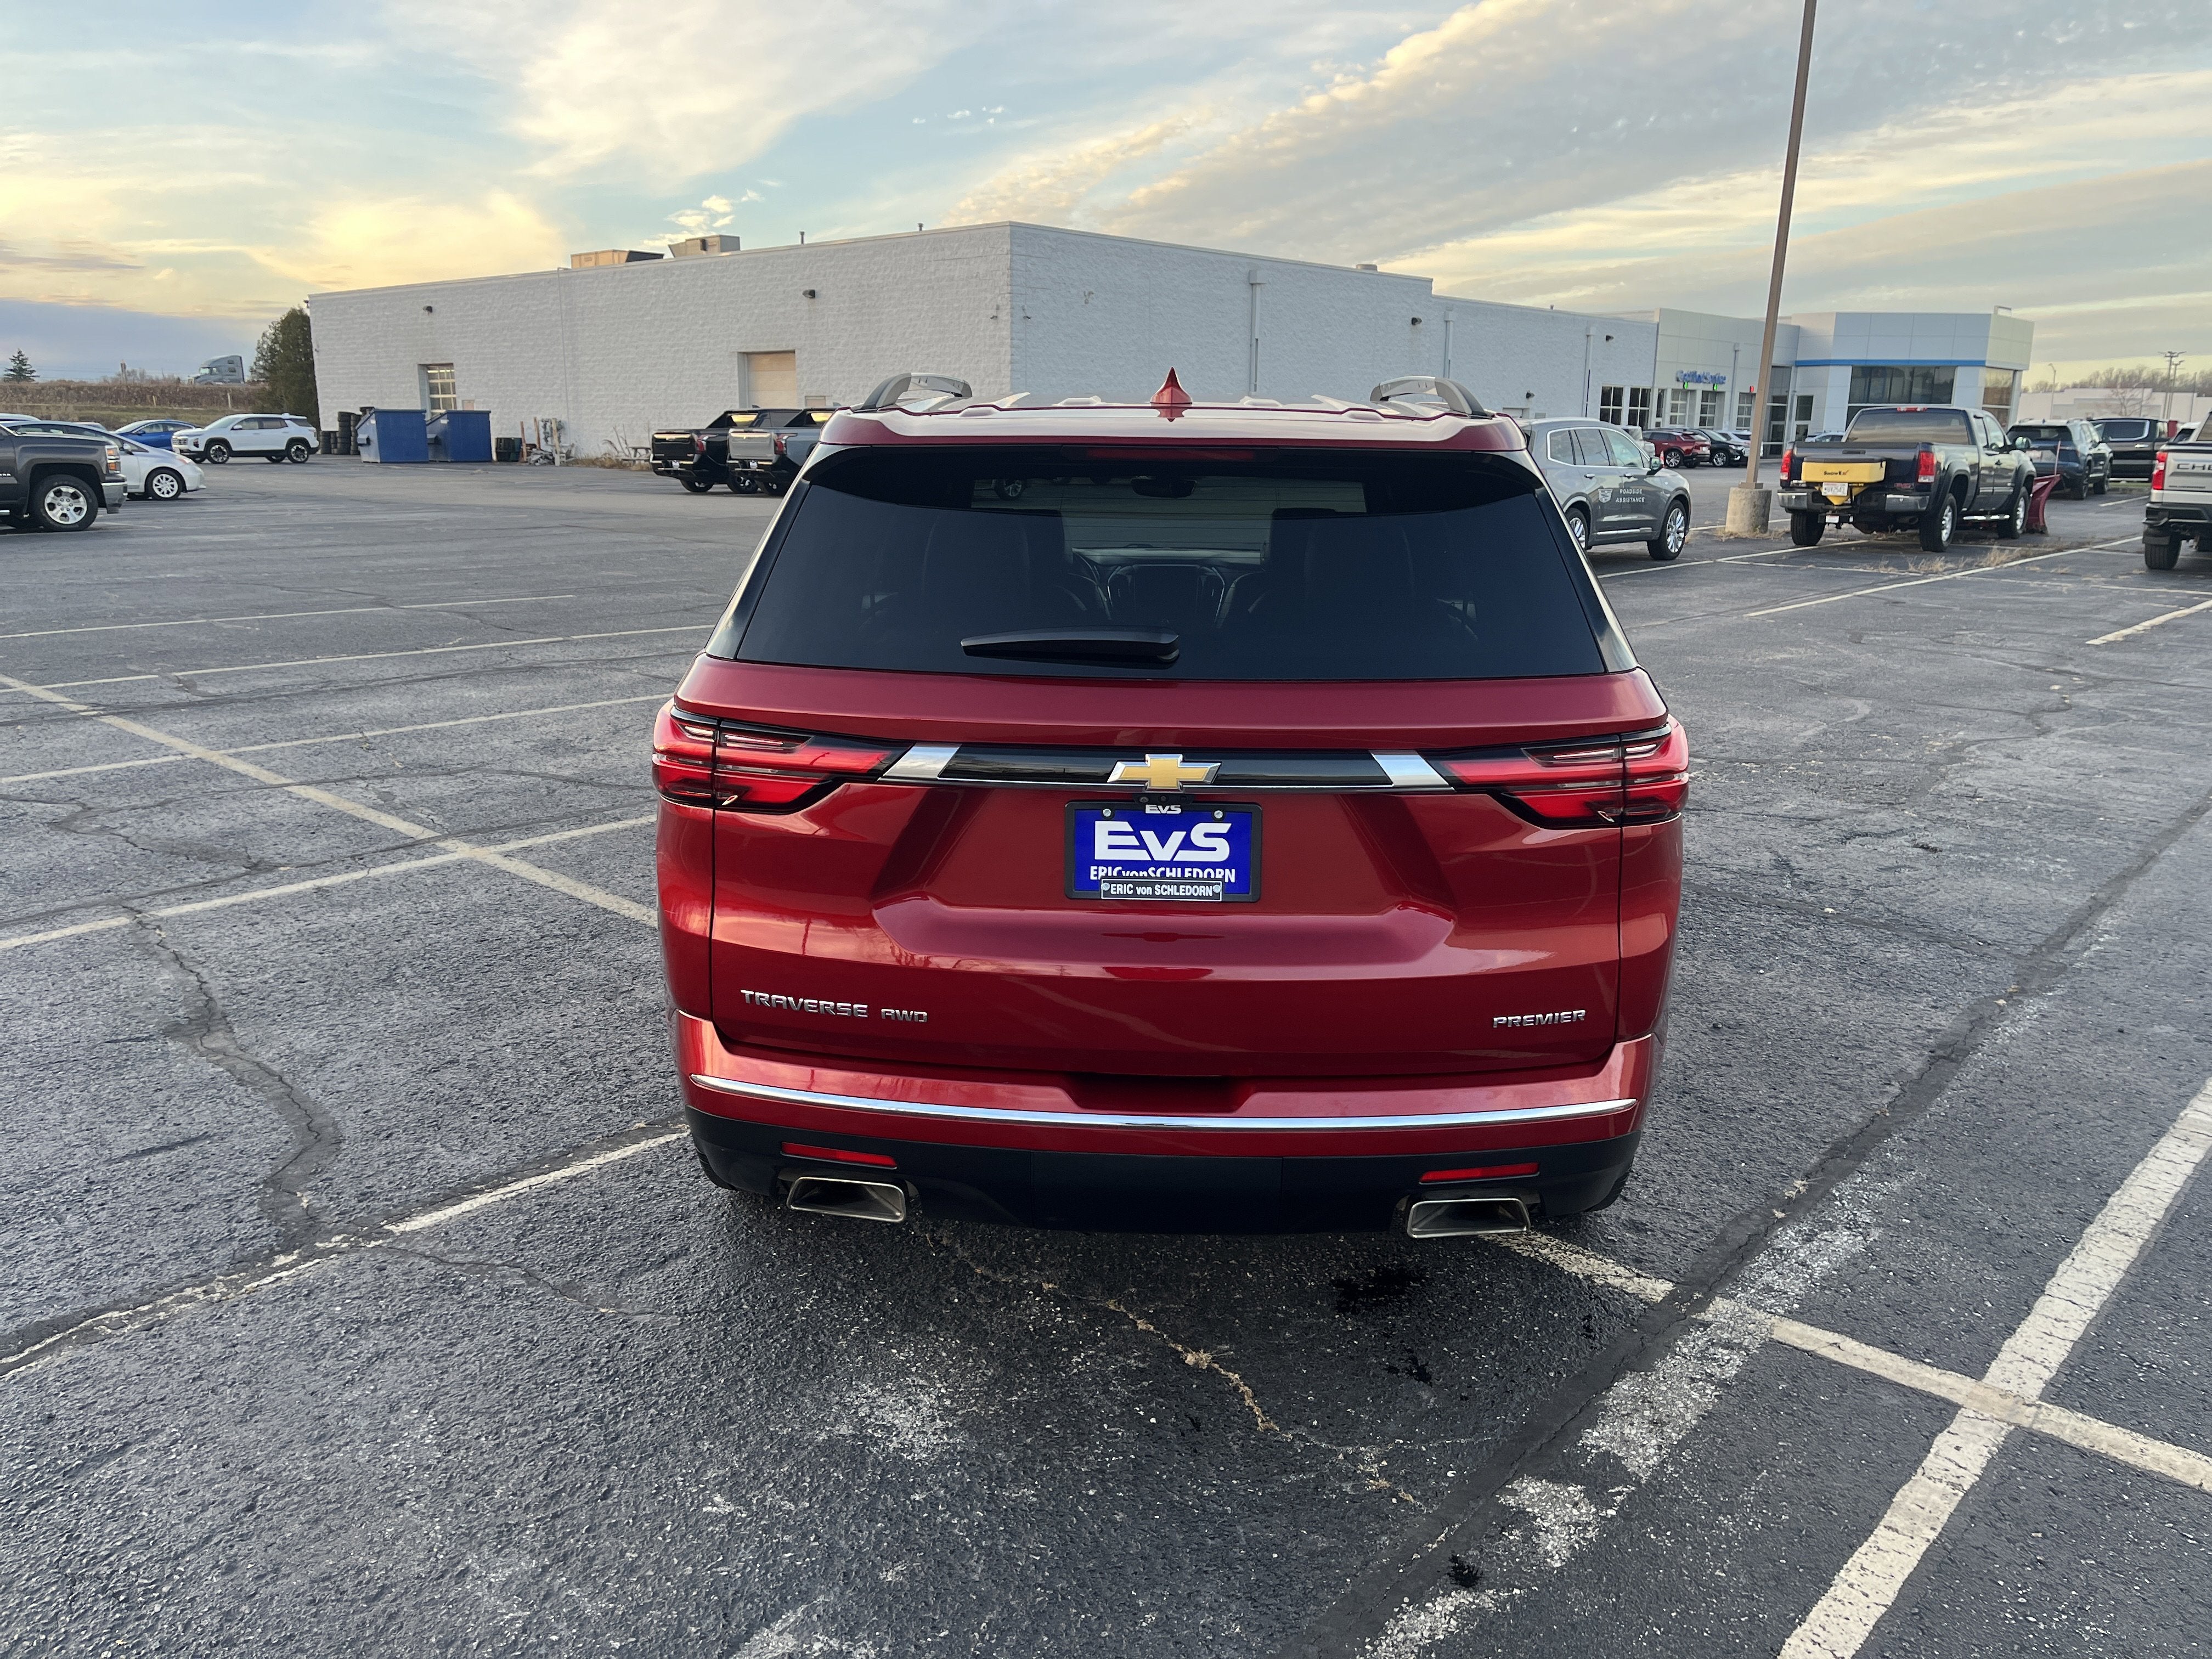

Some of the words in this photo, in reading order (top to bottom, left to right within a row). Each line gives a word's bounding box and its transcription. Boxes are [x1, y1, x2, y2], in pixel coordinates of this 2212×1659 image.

[1110, 884, 1133, 895] ERIC
[1136, 886, 1152, 895] von
[1154, 884, 1213, 896] SCHLEDORN
[741, 989, 868, 1017] TRAVERSE
[881, 1008, 928, 1023] AWD
[1493, 1009, 1585, 1028] PREMIER
